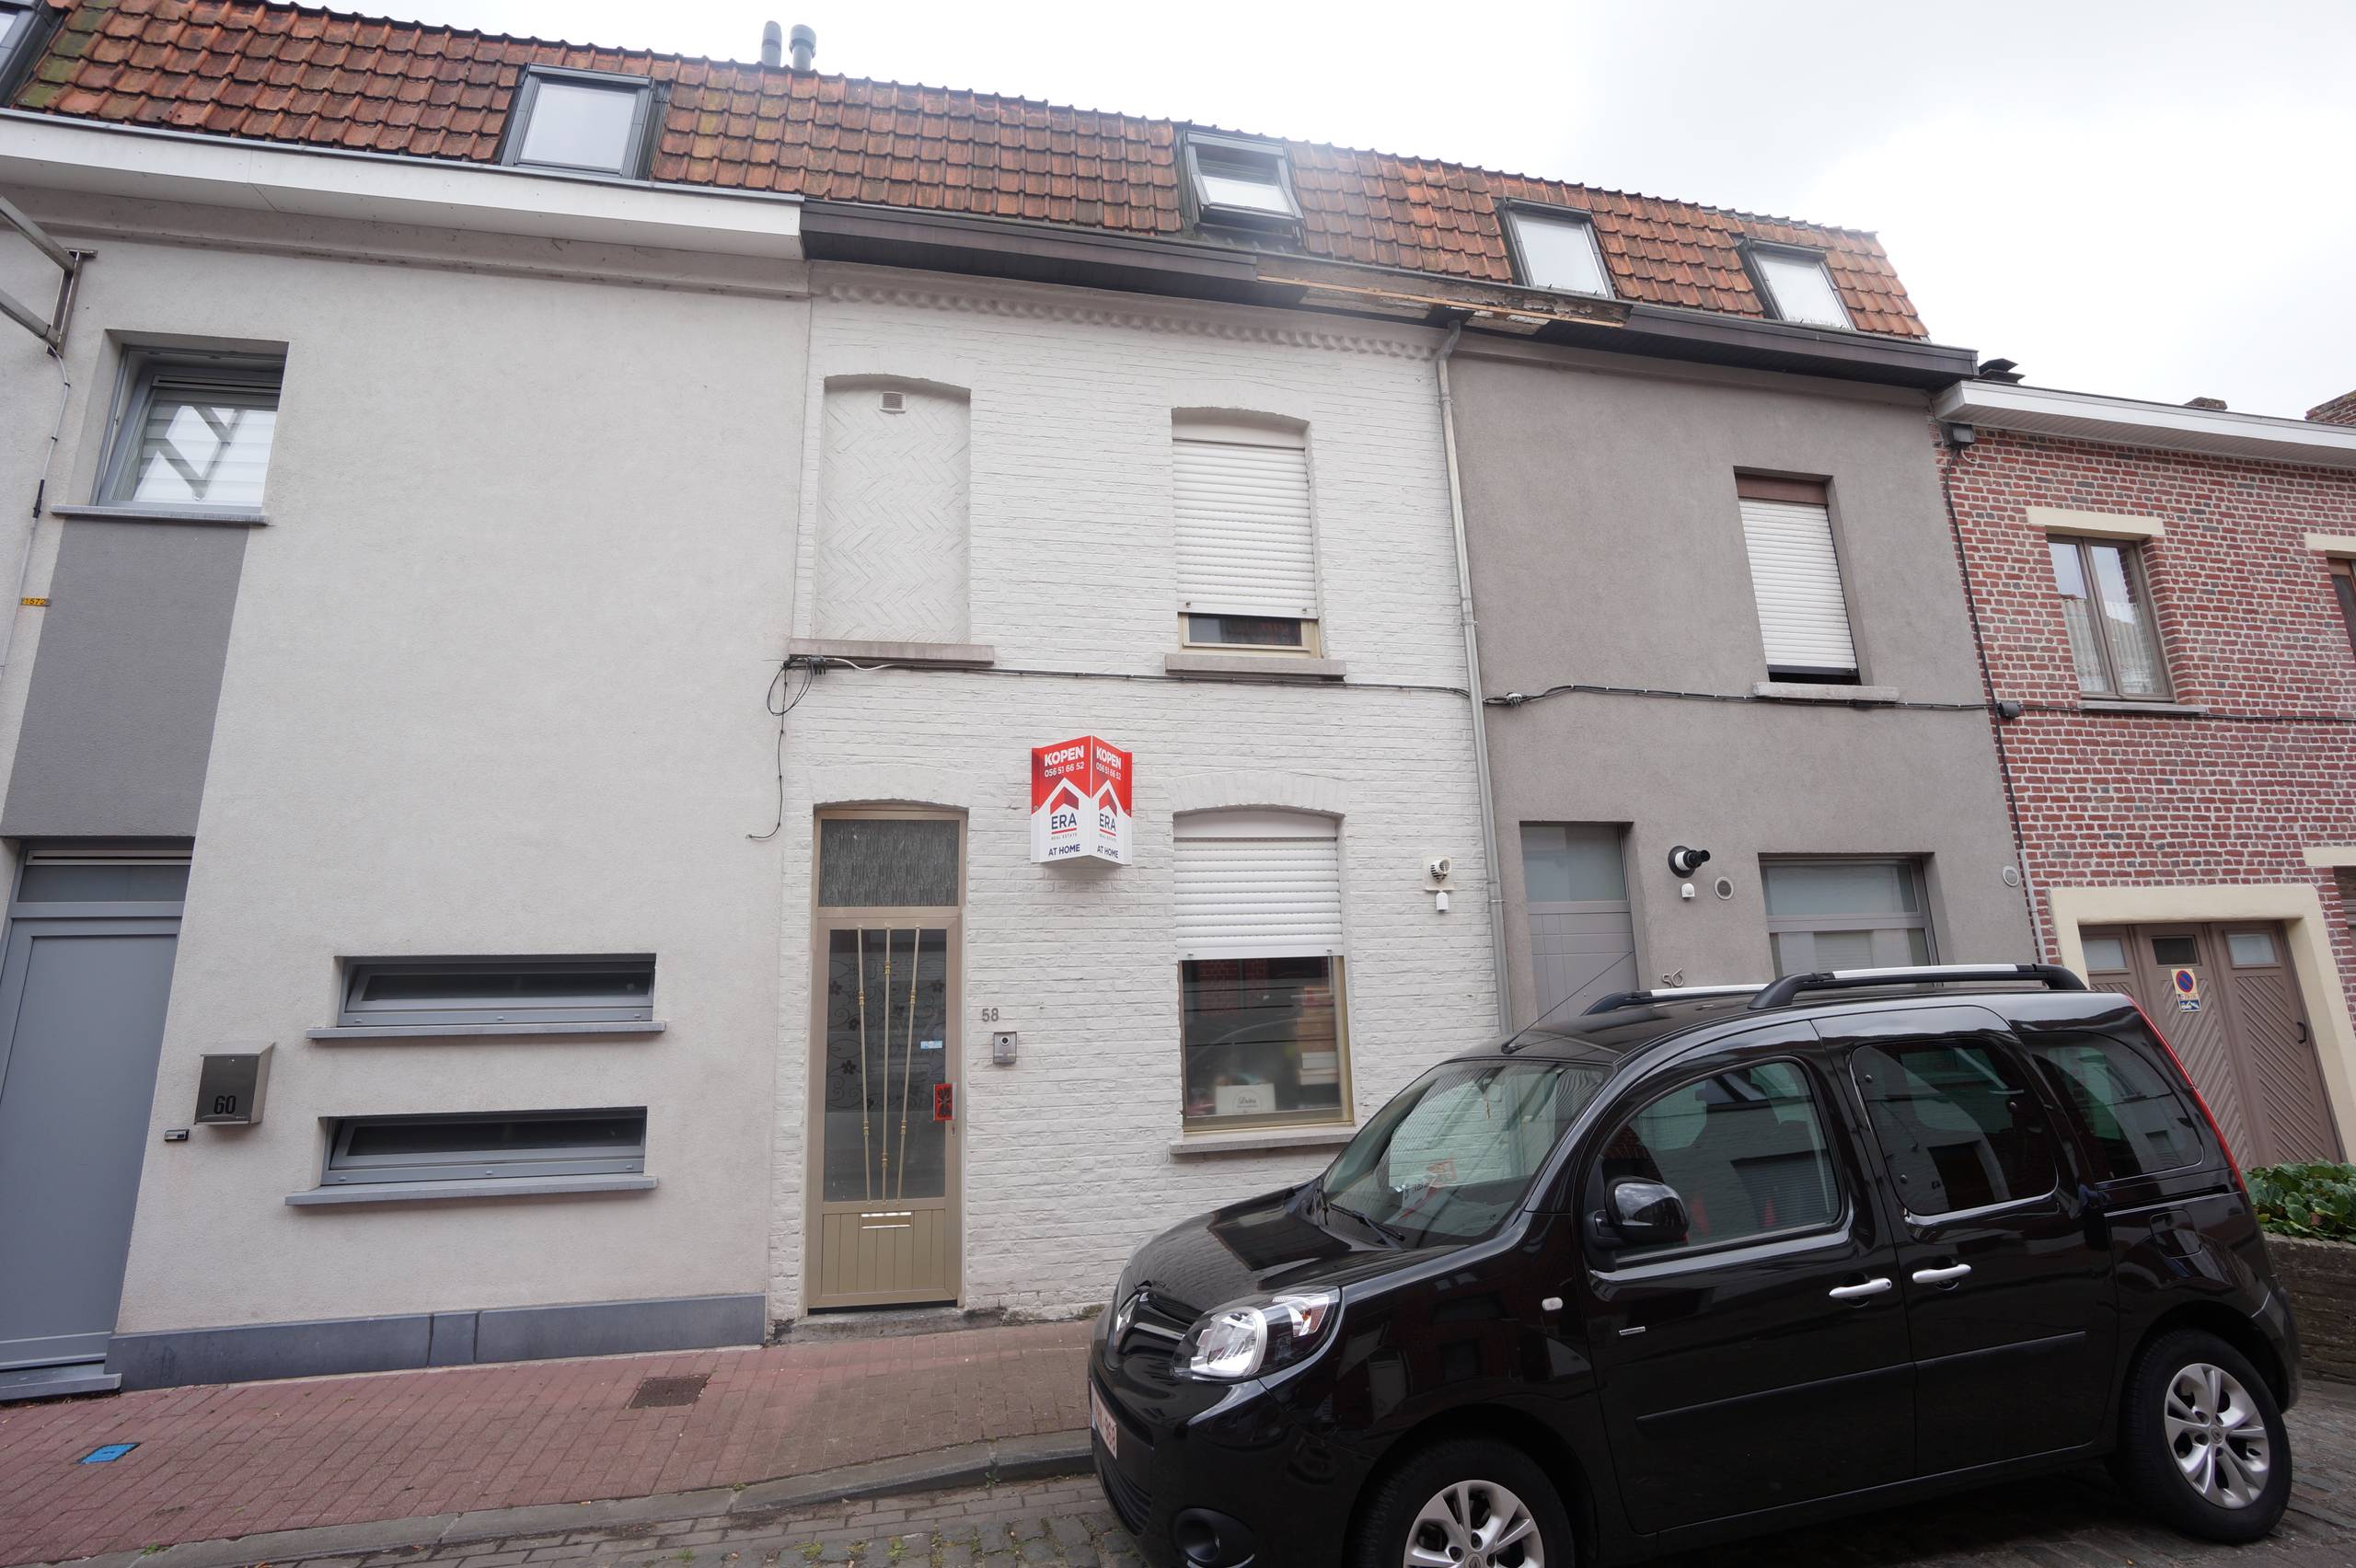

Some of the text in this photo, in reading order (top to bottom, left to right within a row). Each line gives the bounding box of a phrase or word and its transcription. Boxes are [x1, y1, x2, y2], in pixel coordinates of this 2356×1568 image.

[1045, 745, 1084, 767] KOPEN
[1096, 746, 1121, 769] KOPEN
[1045, 762, 1084, 777] 056 51 66 52
[1051, 813, 1077, 829] ERA
[1099, 813, 1116, 832] ERA
[1048, 844, 1080, 856] AT HOME
[1097, 846, 1118, 859] AT HOME
[982, 1008, 999, 1022] 58
[214, 1095, 237, 1114] 60
